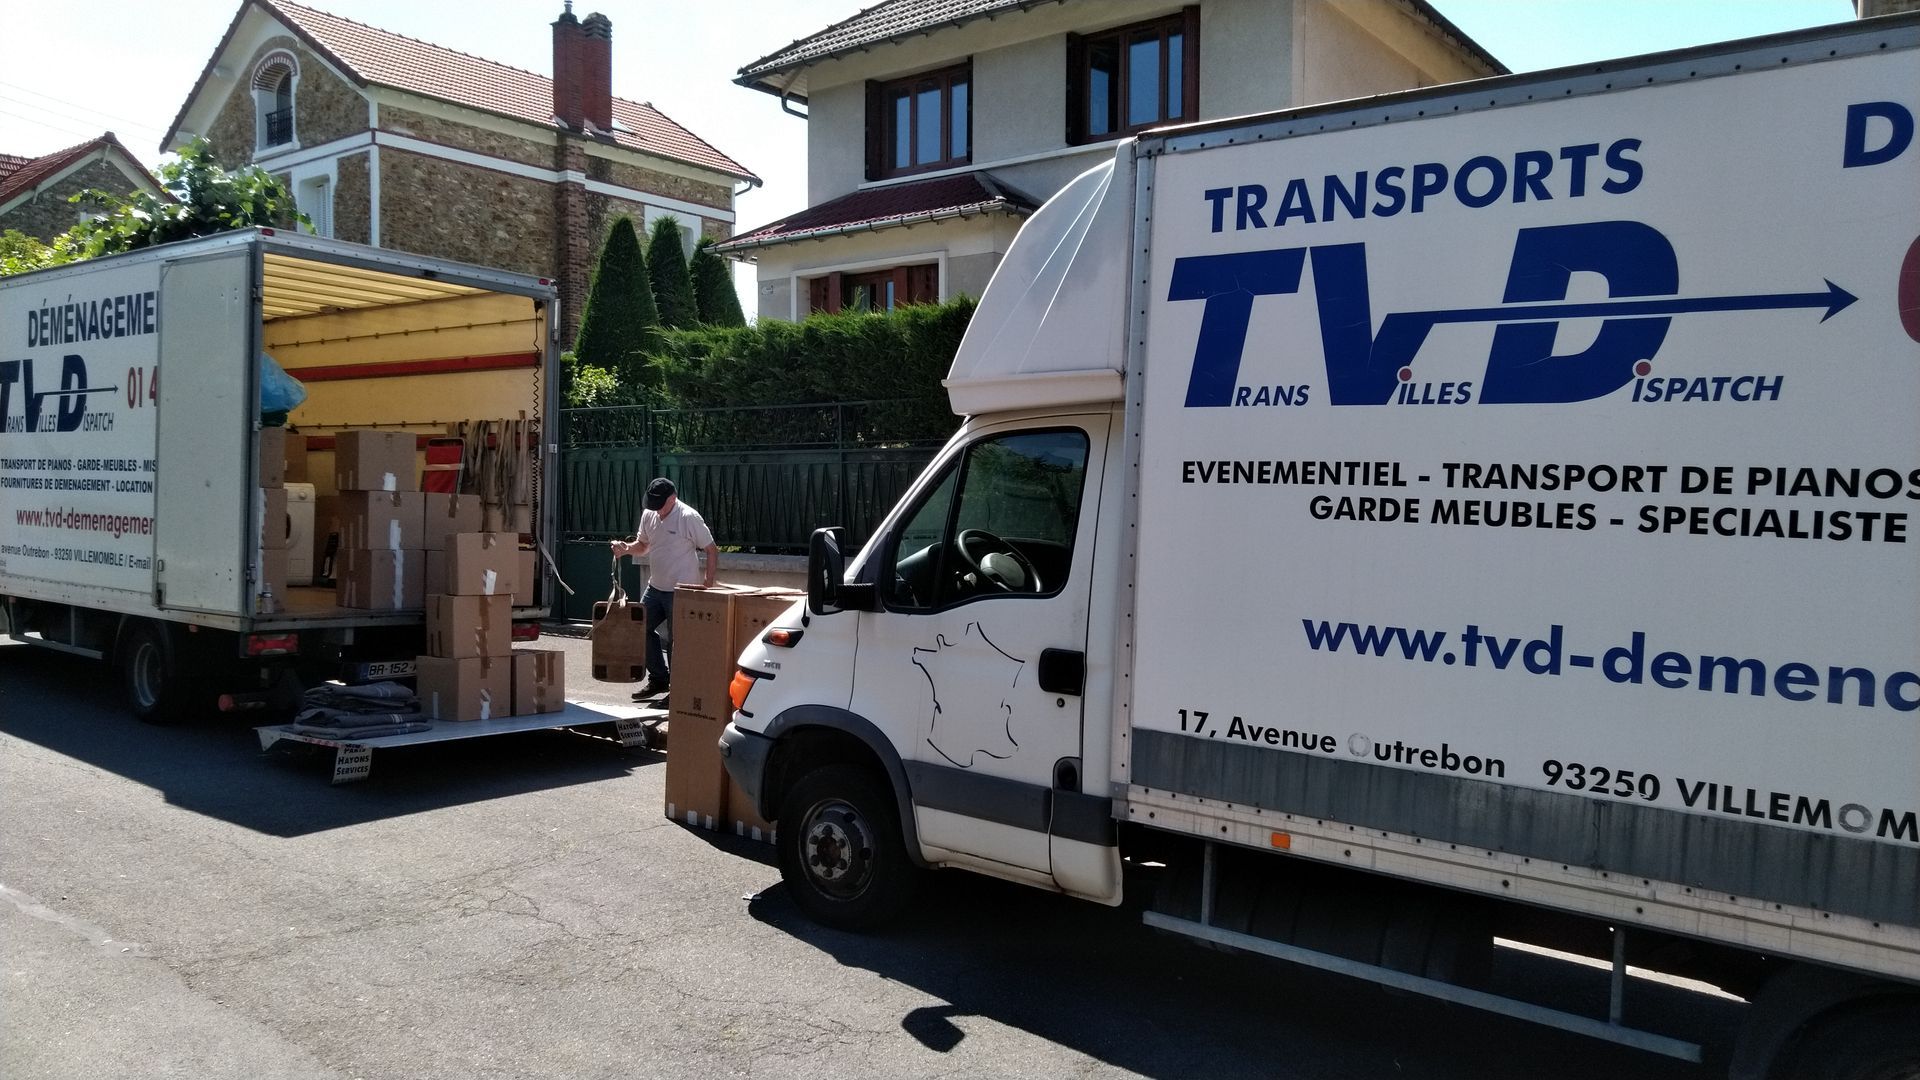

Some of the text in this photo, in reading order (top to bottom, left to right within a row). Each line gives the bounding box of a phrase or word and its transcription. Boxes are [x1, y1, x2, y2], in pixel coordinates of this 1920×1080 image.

[1203, 137, 1644, 234] TRANSPORTS
[28, 291, 159, 348] DÉMÉNAGEME
[1166, 219, 1681, 408] TVD
[127, 366, 143, 410] 01
[0, 458, 37, 470] TRANSPORT
[37, 459, 47, 470] DE
[47, 459, 72, 471] PIANOS
[77, 459, 137, 472] GARDE-MEUBLES
[0, 476, 43, 490] FOURNITURES
[44, 478, 53, 490] DE
[54, 478, 111, 492] DEMENAGEMENT
[116, 480, 153, 494] LOCATION
[1182, 460, 1407, 487] EVENEMENTIEL
[1442, 462, 1668, 493] TRANSPORT
[1680, 466, 1734, 495] DE
[1747, 466, 1920, 501] PIANOS
[1309, 495, 1420, 524] GARDE
[1430, 499, 1597, 531] MEUBLES
[1637, 504, 1908, 544] SPECIALISTE
[54, 547, 73, 561] 93250
[73, 551, 124, 567] VILLEMOMBLE
[337, 755, 370, 765] HAYONS
[1177, 708, 1217, 740] 17,
[1226, 715, 1337, 754] Avenue
[1541, 759, 1660, 800] 93250
